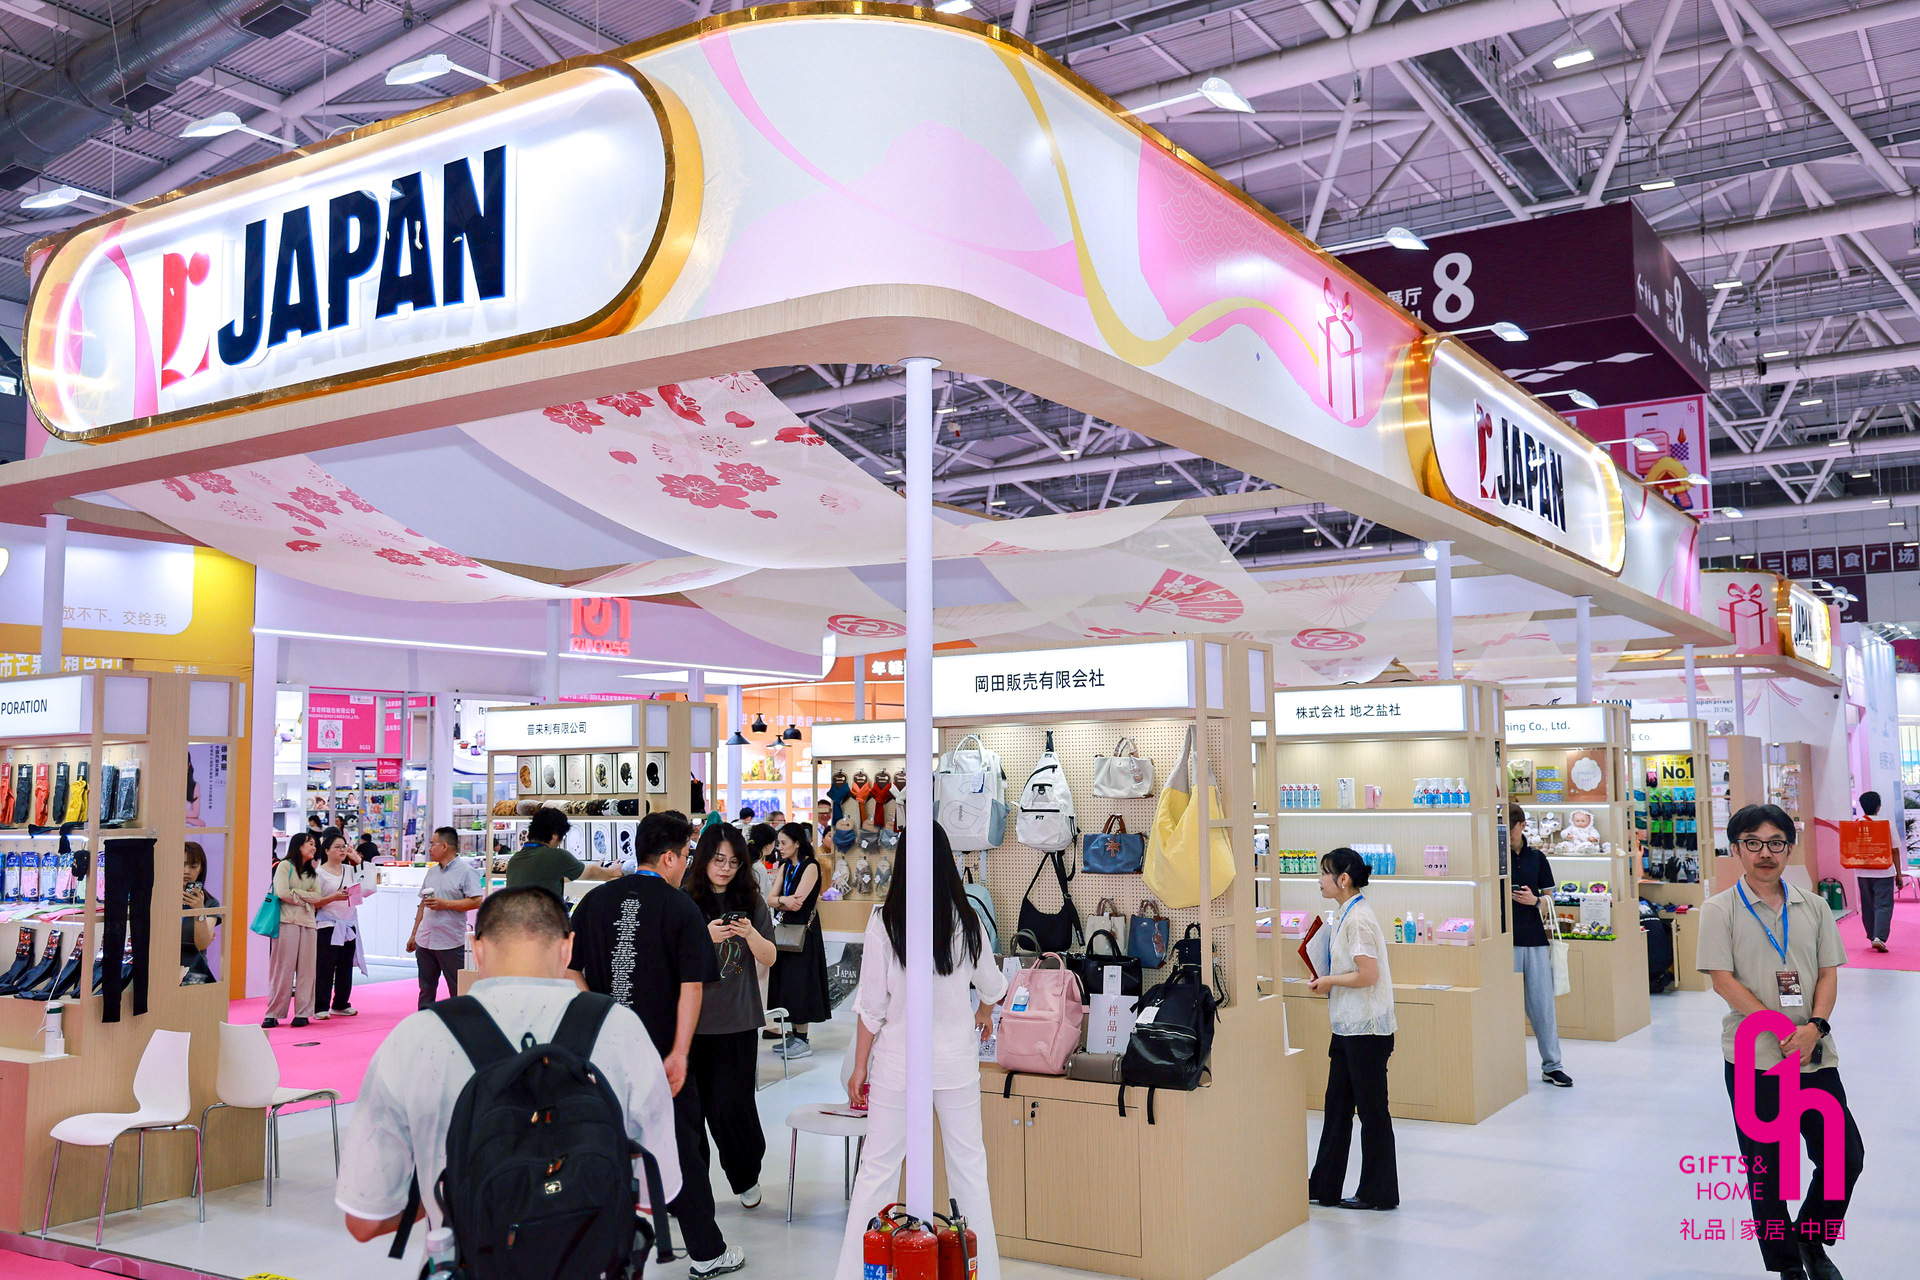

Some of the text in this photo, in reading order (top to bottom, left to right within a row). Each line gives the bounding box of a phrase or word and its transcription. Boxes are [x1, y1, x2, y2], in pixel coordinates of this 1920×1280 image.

[218, 144, 507, 367] JAPAN
[1432, 252, 1475, 324] 8
[1673, 275, 1685, 344] 8
[1497, 416, 1567, 534] JAPAN
[1767, 549, 1916, 573] 三楼美食广场
[975, 668, 1105, 693] 岡田販売有限会社
[1296, 703, 1401, 719] 株式会社 地之盐社
[1529, 722, 1548, 732] Co.,
[1551, 721, 1570, 730] Ltd.
[1639, 733, 1653, 741] Co.
[1662, 757, 1694, 779] No.1
[834, 965, 857, 978] JAPAN
[1106, 1004, 1119, 1053] 样品可
